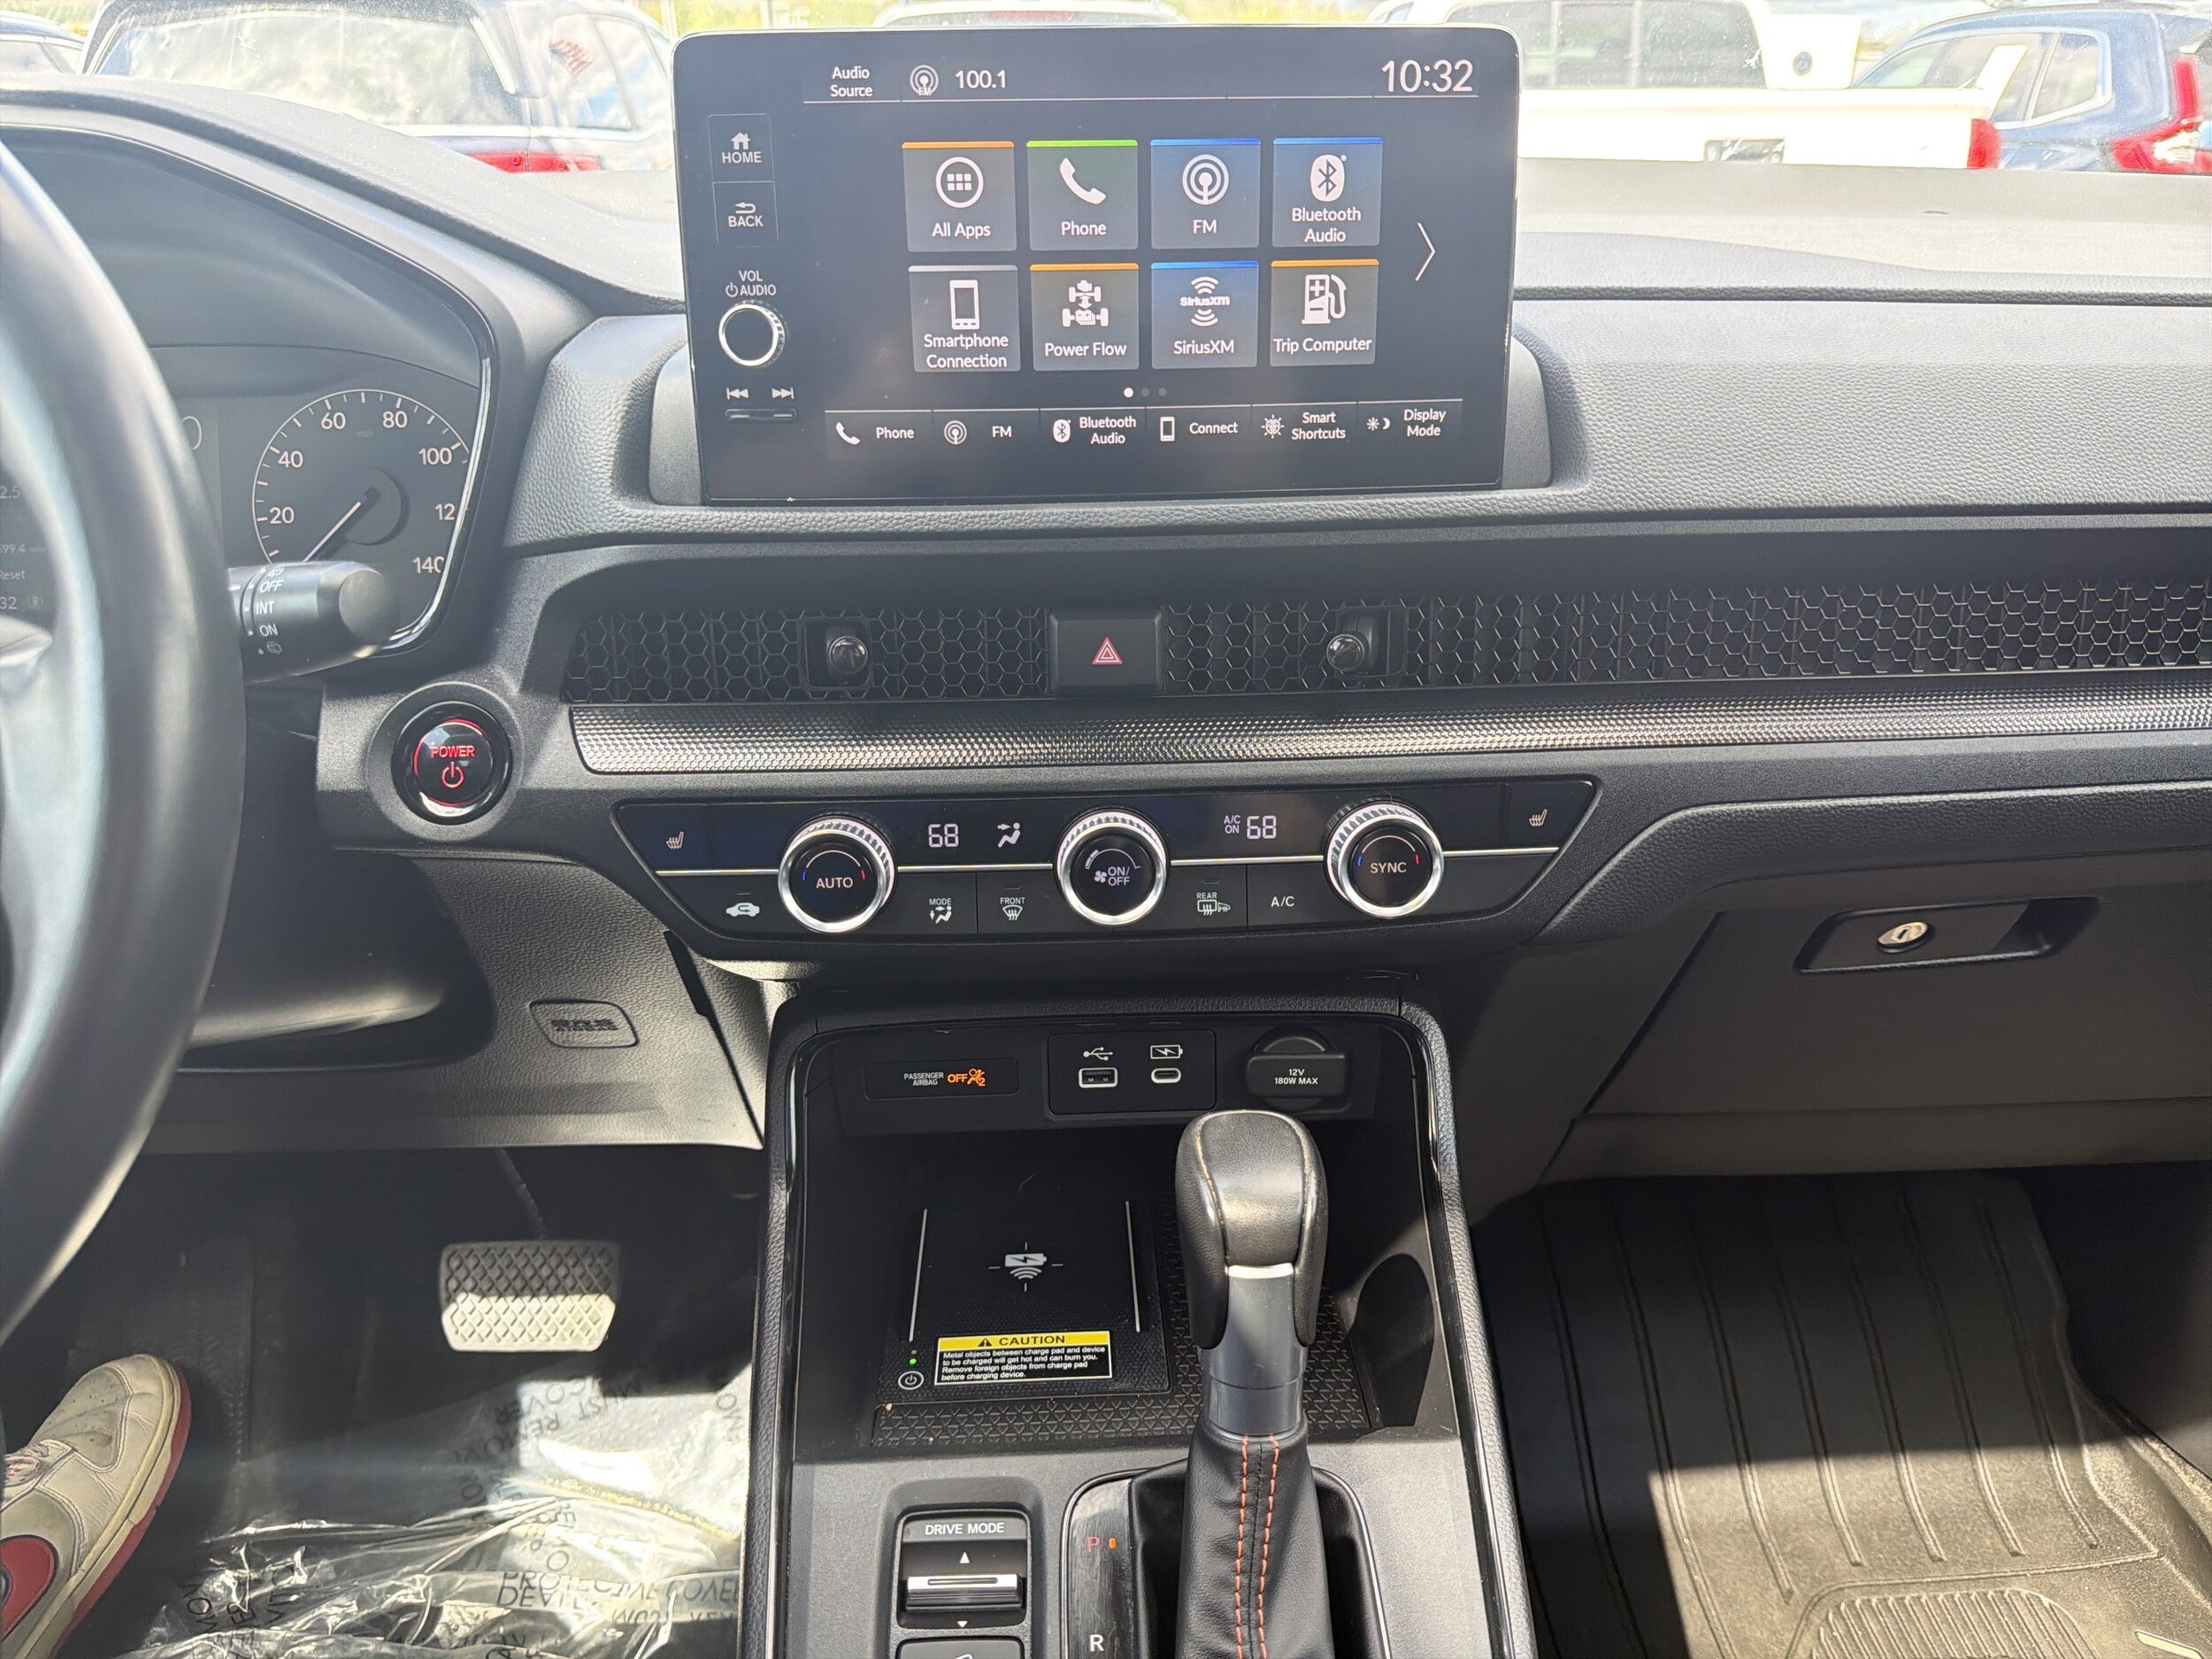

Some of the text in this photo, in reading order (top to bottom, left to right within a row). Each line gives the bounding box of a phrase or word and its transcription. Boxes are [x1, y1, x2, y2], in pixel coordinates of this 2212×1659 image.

[832, 65, 870, 80] Audio
[955, 69, 1007, 89] 100.1
[1381, 59, 1474, 93] 10:32
[830, 83, 873, 97] Source
[721, 151, 763, 164] HOME
[728, 215, 764, 228] BACK
[1291, 207, 1362, 222] Bluetooth
[932, 222, 991, 240] All Apps
[1061, 220, 1107, 236] Phone
[1193, 219, 1217, 234] FM
[1304, 228, 1346, 242] Audio
[738, 270, 764, 281] VOL
[740, 284, 777, 296] AUDIO
[924, 334, 1009, 349] Smartphone
[1173, 340, 1234, 355] SiriusXM
[1273, 338, 1372, 354] Trip Computer
[1045, 342, 1127, 357] Power Flow
[926, 355, 1007, 368] Connection
[320, 411, 347, 430] 60
[382, 411, 408, 428] 80
[1302, 411, 1336, 424] Smart
[1403, 408, 1447, 423] Display
[1079, 416, 1137, 430] Bluetooth
[1189, 421, 1238, 434] Connect
[876, 426, 914, 440] Phone
[992, 426, 1012, 438] FM
[1090, 431, 1125, 444] Audio
[1291, 426, 1346, 440] Shortcuts
[1407, 424, 1440, 437] Mode
[278, 450, 303, 468] 40
[419, 447, 453, 465] 100
[270, 507, 296, 525] 20
[434, 503, 458, 520] 12
[260, 580, 284, 593] OFF
[256, 601, 275, 615] INT
[259, 623, 279, 637] ON
[431, 745, 475, 758] POWER
[1224, 815, 1240, 825] A/C
[1225, 825, 1239, 834] ON
[1247, 816, 1277, 840] 68
[928, 824, 959, 848] 68
[1108, 866, 1131, 877] ON/
[1370, 861, 1407, 874] SYNC
[816, 876, 854, 889] AUTO
[1108, 876, 1131, 887] OFF
[929, 897, 952, 906] MODE
[999, 896, 1025, 905] FRONT
[1271, 895, 1294, 908] A/C
[903, 1071, 944, 1080] PASSENGER
[947, 1073, 968, 1084] OFF
[1288, 1068, 1305, 1077] 12V
[1274, 1077, 1318, 1086] 180W MAX
[999, 1335, 1065, 1346] CAUTION
[925, 1522, 1005, 1536] DRIVE MODE
[1087, 1535, 1101, 1553] P
[1089, 1633, 1104, 1653] R
